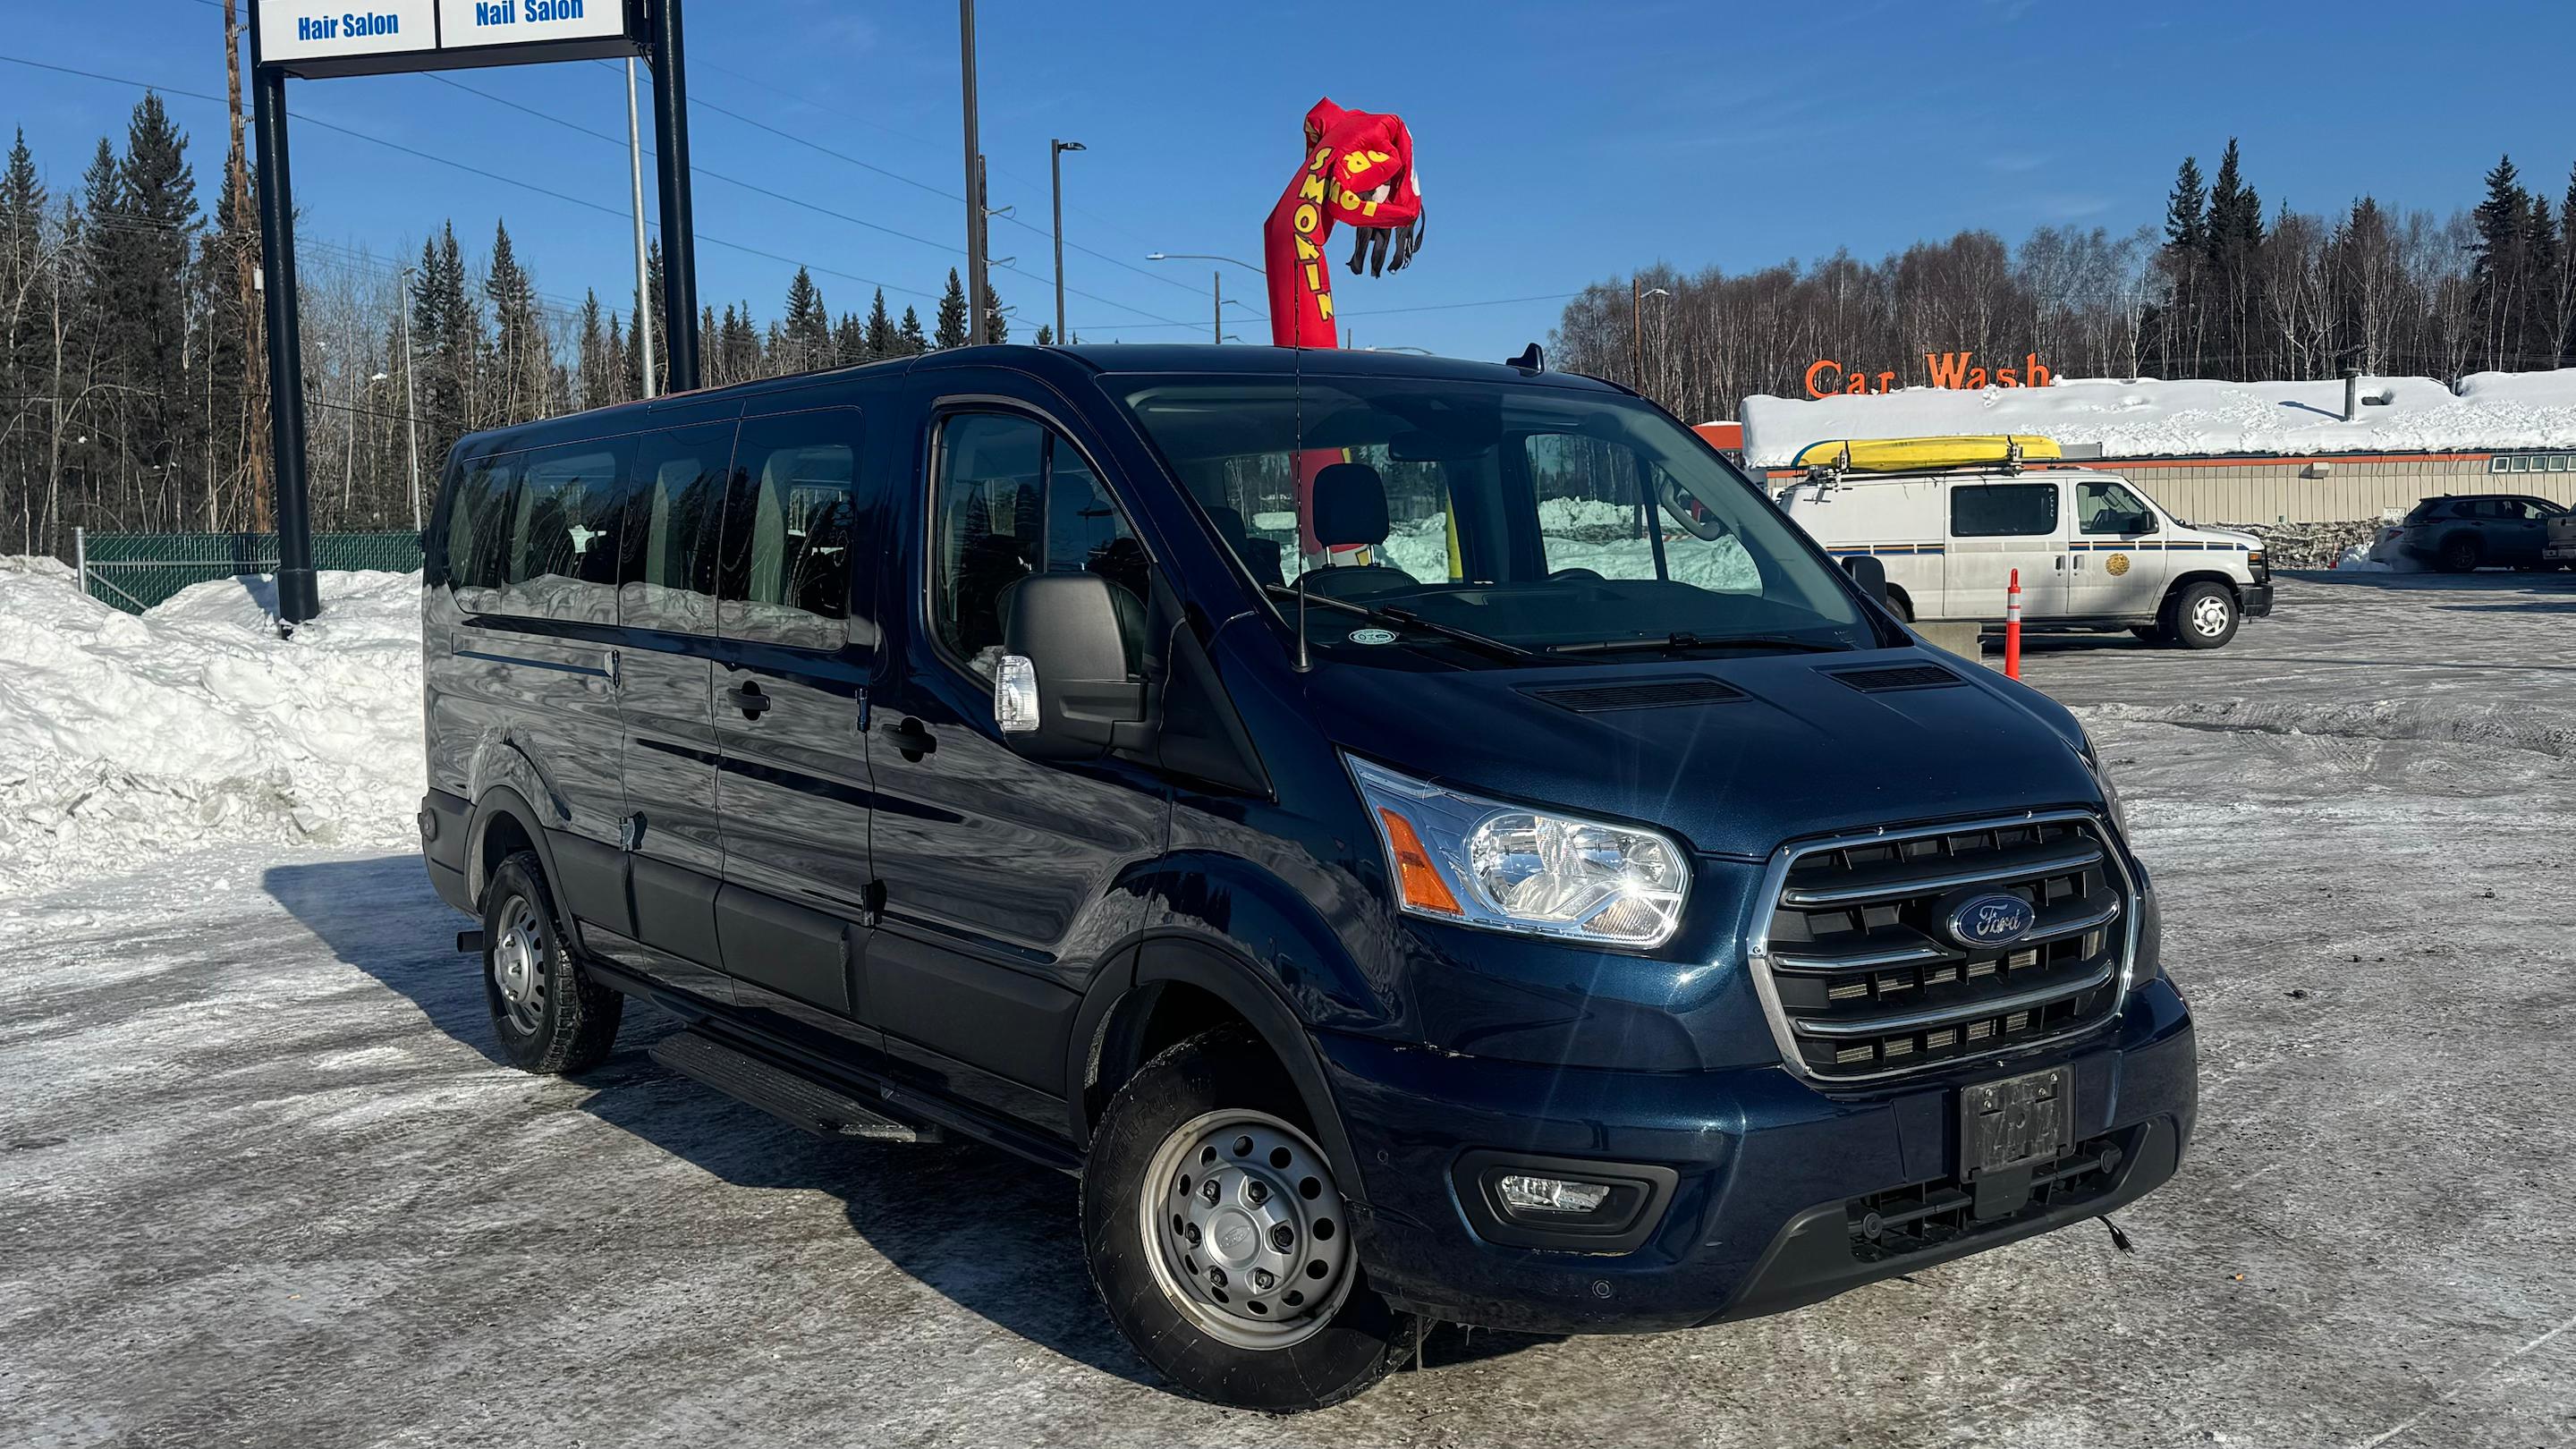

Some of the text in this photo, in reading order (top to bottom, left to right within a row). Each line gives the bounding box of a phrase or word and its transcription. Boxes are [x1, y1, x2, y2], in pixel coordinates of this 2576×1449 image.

[298, 13, 399, 40] Hair Salon
[477, 0, 584, 26] Nail Salon
[1804, 352, 2050, 399] Car Wash
[1977, 904, 2021, 936] Ford
